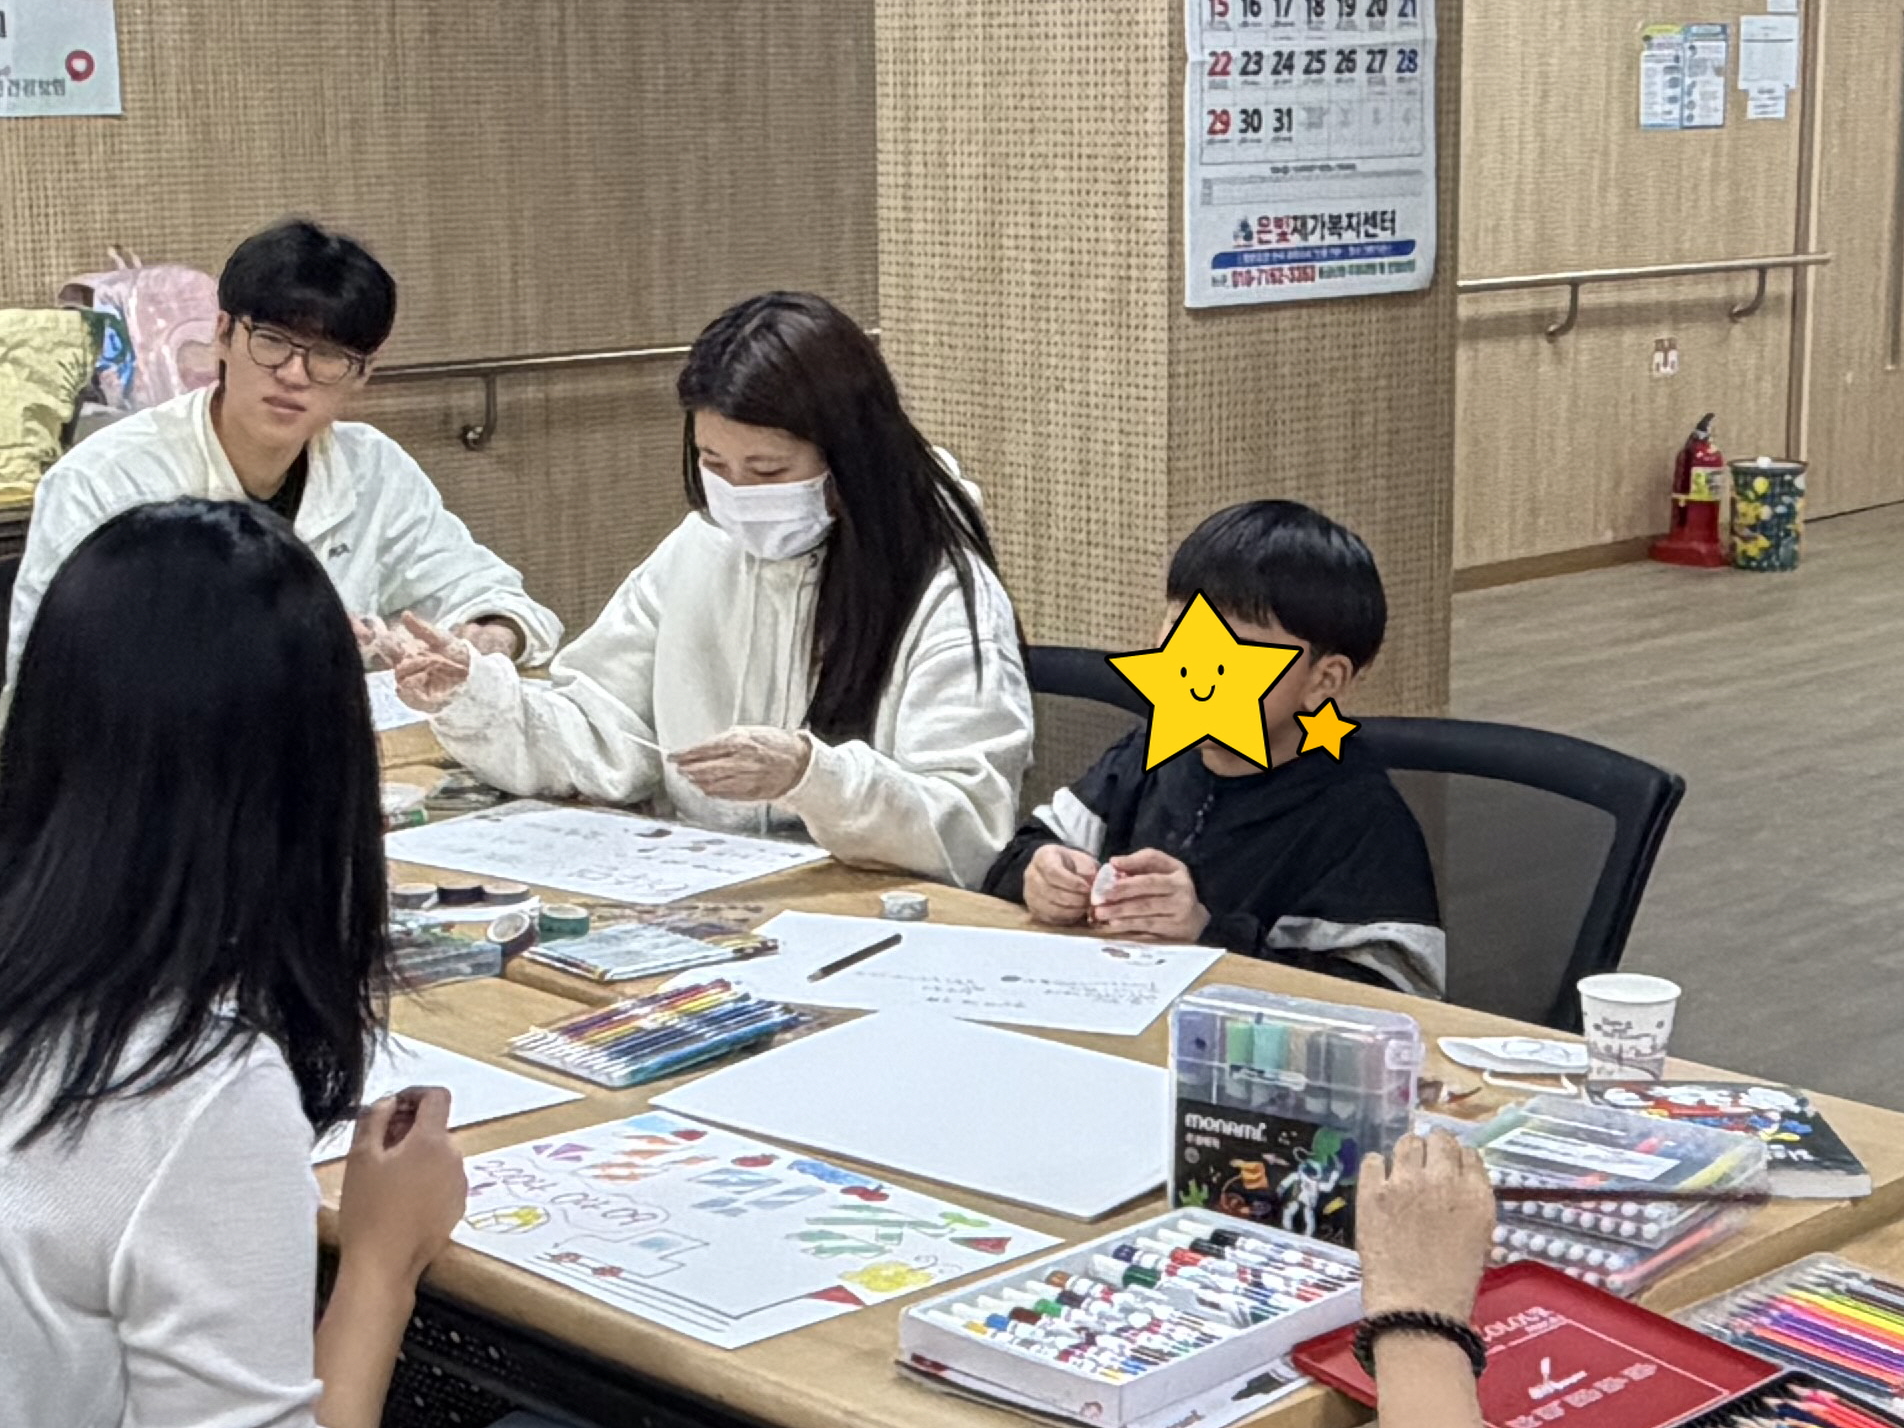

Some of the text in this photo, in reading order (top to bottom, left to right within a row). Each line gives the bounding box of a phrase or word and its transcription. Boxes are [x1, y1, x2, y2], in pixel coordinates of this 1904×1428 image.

[1207, 48, 1418, 77] 22 23 24 25 26 27 28
[1206, 108, 1231, 136] 29
[1238, 108, 1262, 134] 30
[1272, 107, 1293, 133] 31
